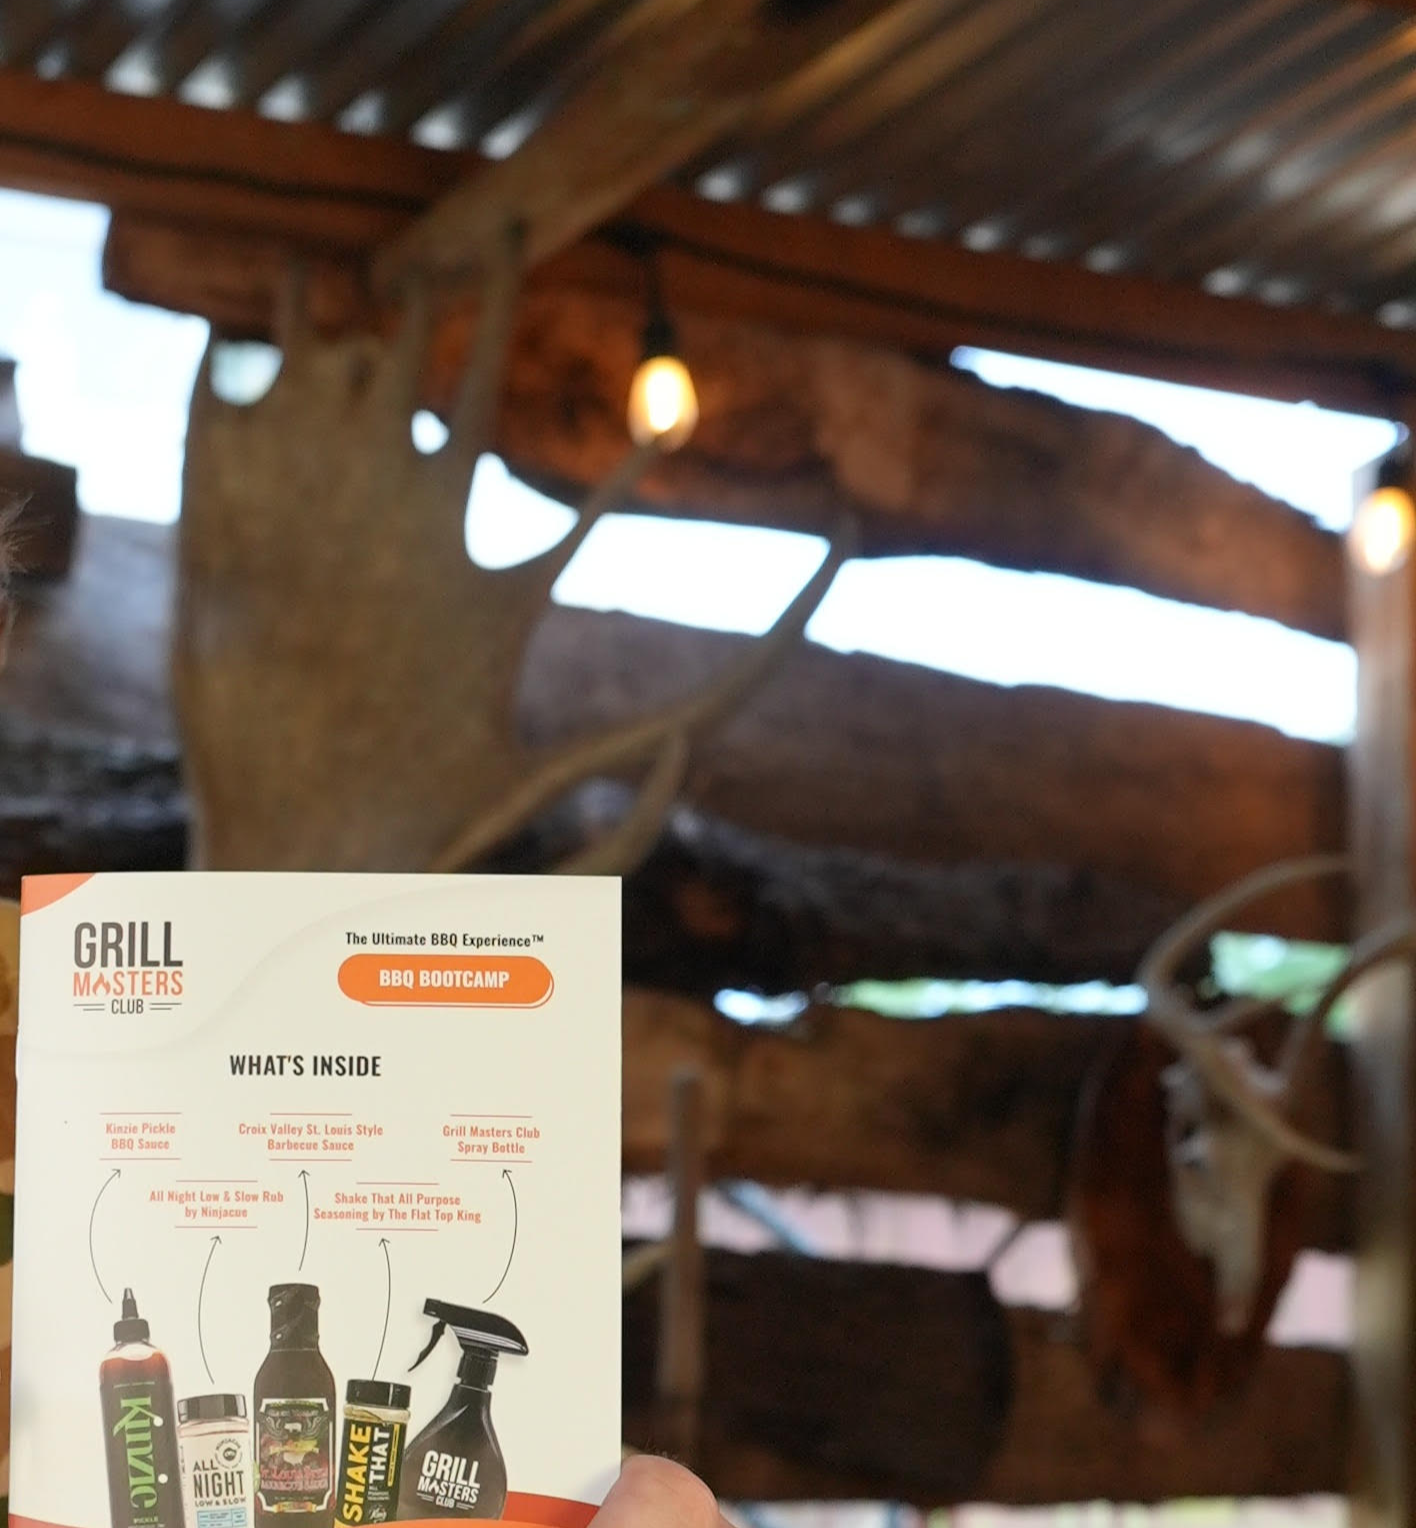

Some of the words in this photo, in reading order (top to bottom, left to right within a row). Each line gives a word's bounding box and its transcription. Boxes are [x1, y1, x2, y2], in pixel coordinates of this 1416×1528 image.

[73, 921, 183, 968] GRILL
[346, 932, 367, 946] The
[372, 932, 426, 946] Ultimate
[431, 933, 457, 947] BBQ
[73, 969, 183, 997] MASTERS
[379, 969, 414, 989] BBQ
[419, 969, 510, 989] BOOTCAMP
[111, 999, 144, 1014] CLUB
[229, 1054, 304, 1077] WHAT'S
[312, 1055, 382, 1077] INSIDE
[105, 1123, 138, 1134] Kinzie
[142, 1123, 176, 1134] Pickle
[239, 1124, 266, 1135] Croix
[270, 1124, 303, 1138] Valley
[307, 1124, 321, 1136] St.
[325, 1124, 352, 1136] Louis
[356, 1124, 383, 1138] Style
[443, 1125, 467, 1138] Grill
[470, 1126, 512, 1138] Masters
[516, 1126, 540, 1139] Club
[111, 1138, 134, 1151] BBQ
[138, 1138, 170, 1150] Sauce
[268, 1139, 318, 1151] Barbecue
[322, 1139, 354, 1151] Sauce
[458, 1141, 488, 1155] Spray
[492, 1141, 525, 1154] Bottle
[150, 1190, 164, 1202] All
[168, 1190, 196, 1204] Night
[200, 1191, 220, 1202] Low
[223, 1191, 230, 1202] &
[234, 1191, 259, 1202] Slow
[263, 1191, 284, 1203] Rub
[335, 1193, 368, 1205] Shake
[371, 1193, 396, 1205] That
[399, 1193, 413, 1205] All
[417, 1193, 461, 1208] Purpose
[185, 1207, 197, 1218] by
[201, 1206, 248, 1219] Ninjacue
[314, 1208, 369, 1222] Seasoning
[373, 1208, 385, 1222] by
[389, 1209, 407, 1220] The
[411, 1209, 431, 1221] Flat
[434, 1209, 454, 1223] Top
[457, 1210, 482, 1224] King
[368, 1427, 389, 1484] THAT
[193, 1460, 218, 1472] ALL
[343, 1424, 371, 1522] SHAKE
[422, 1450, 480, 1489] GRILL
[194, 1471, 244, 1498] NIGHT
[417, 1476, 479, 1504] MASTERS
[436, 1495, 455, 1508] CLUB
